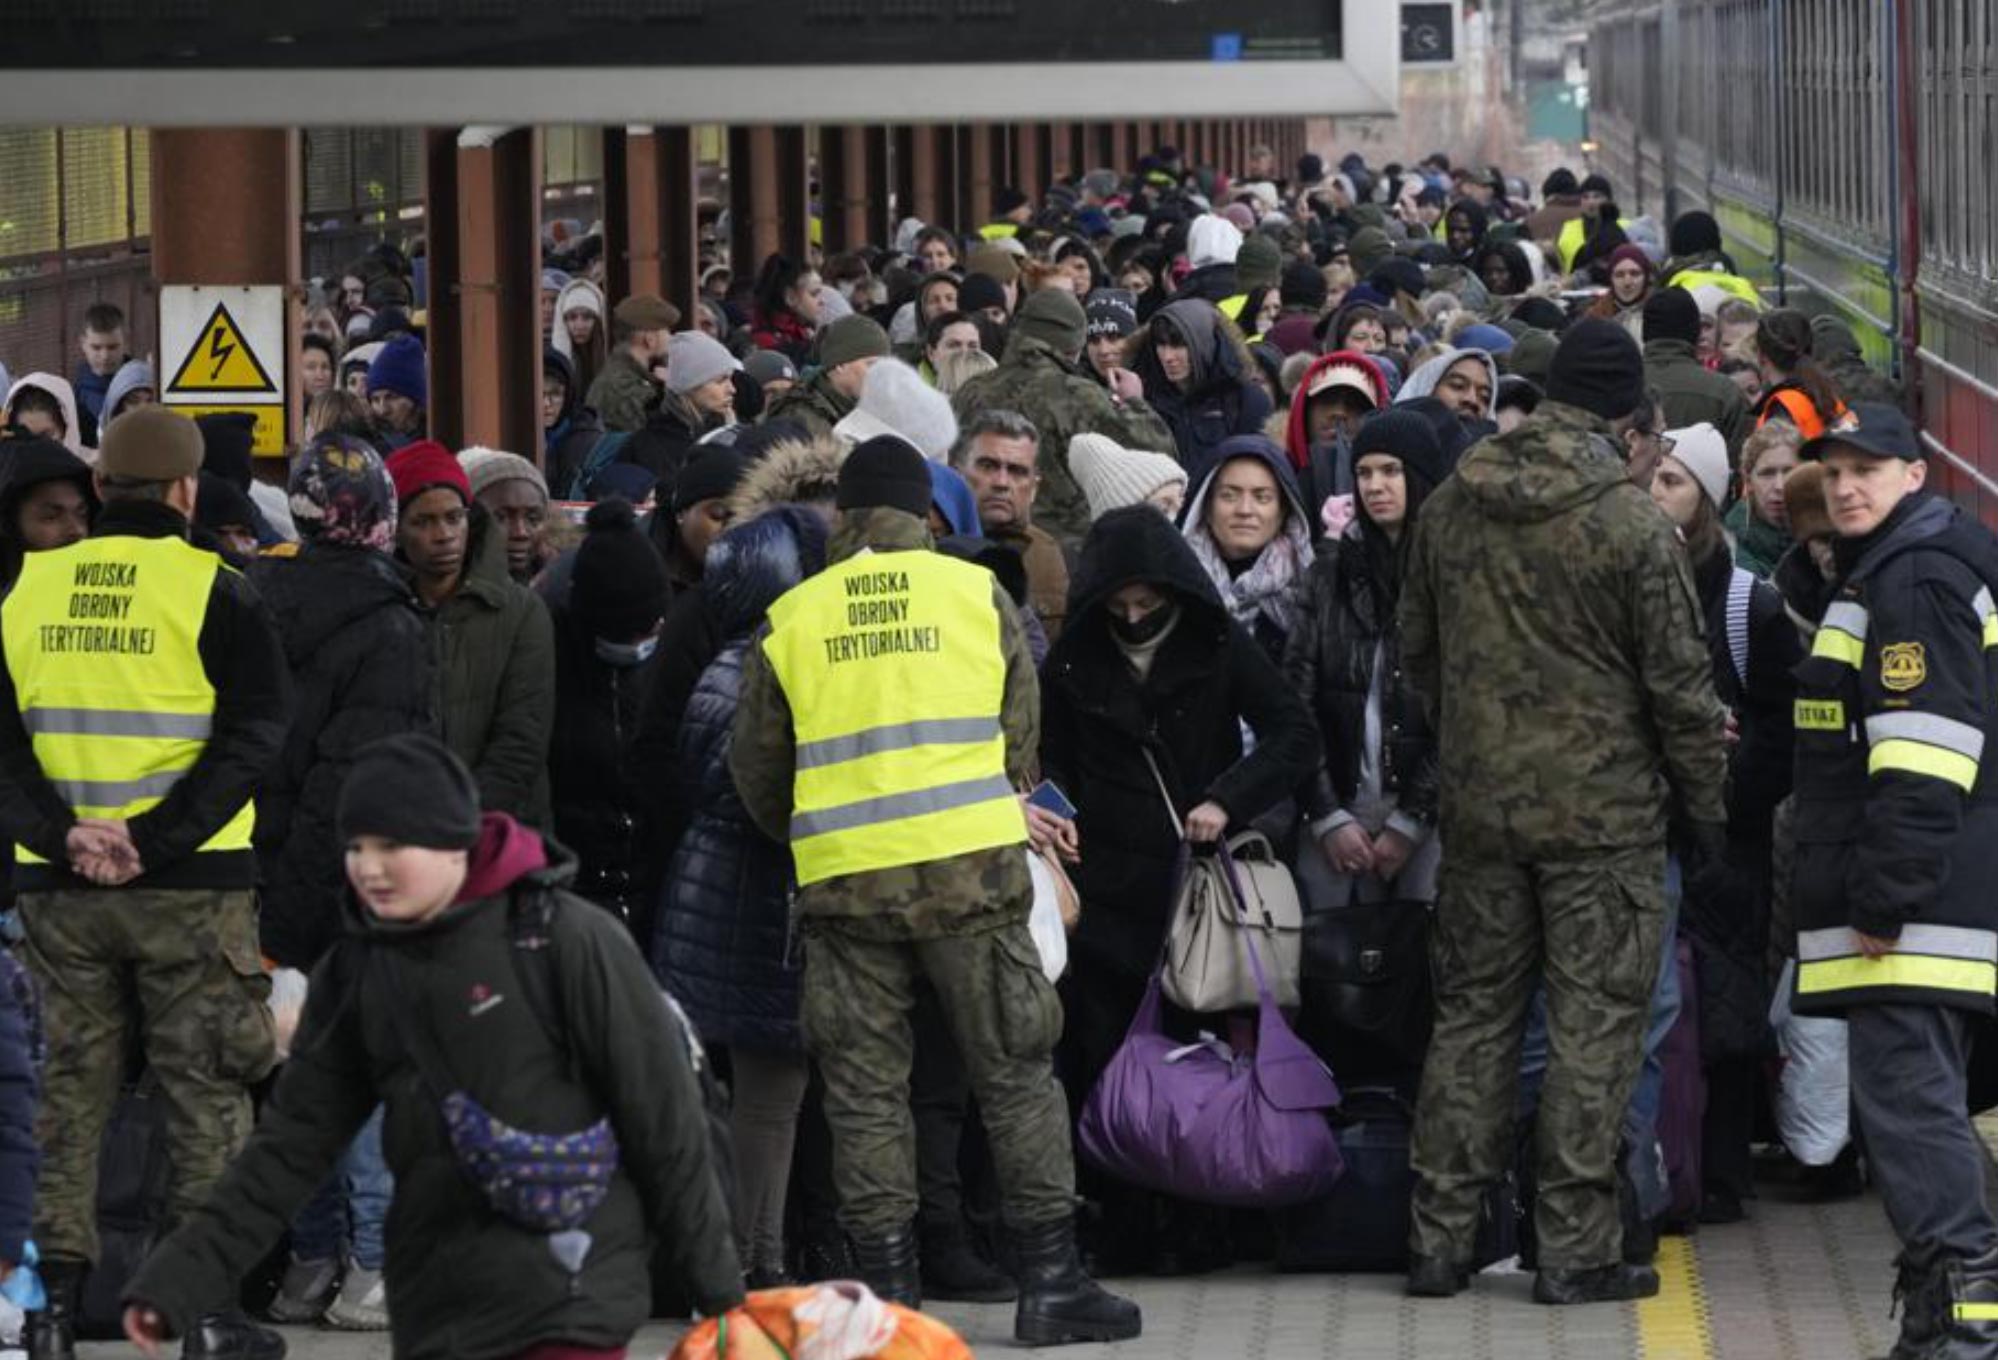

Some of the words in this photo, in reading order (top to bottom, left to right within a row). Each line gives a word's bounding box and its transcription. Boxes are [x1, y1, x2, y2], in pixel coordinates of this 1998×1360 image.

[74, 562, 138, 588] WOJSKA
[844, 571, 910, 597] WOJSKA
[68, 592, 133, 620] OBRONY
[847, 597, 910, 627] OBRONY
[40, 624, 156, 655] TERYTORIALNEJ
[824, 626, 940, 664] TERYTORIALNEJ
